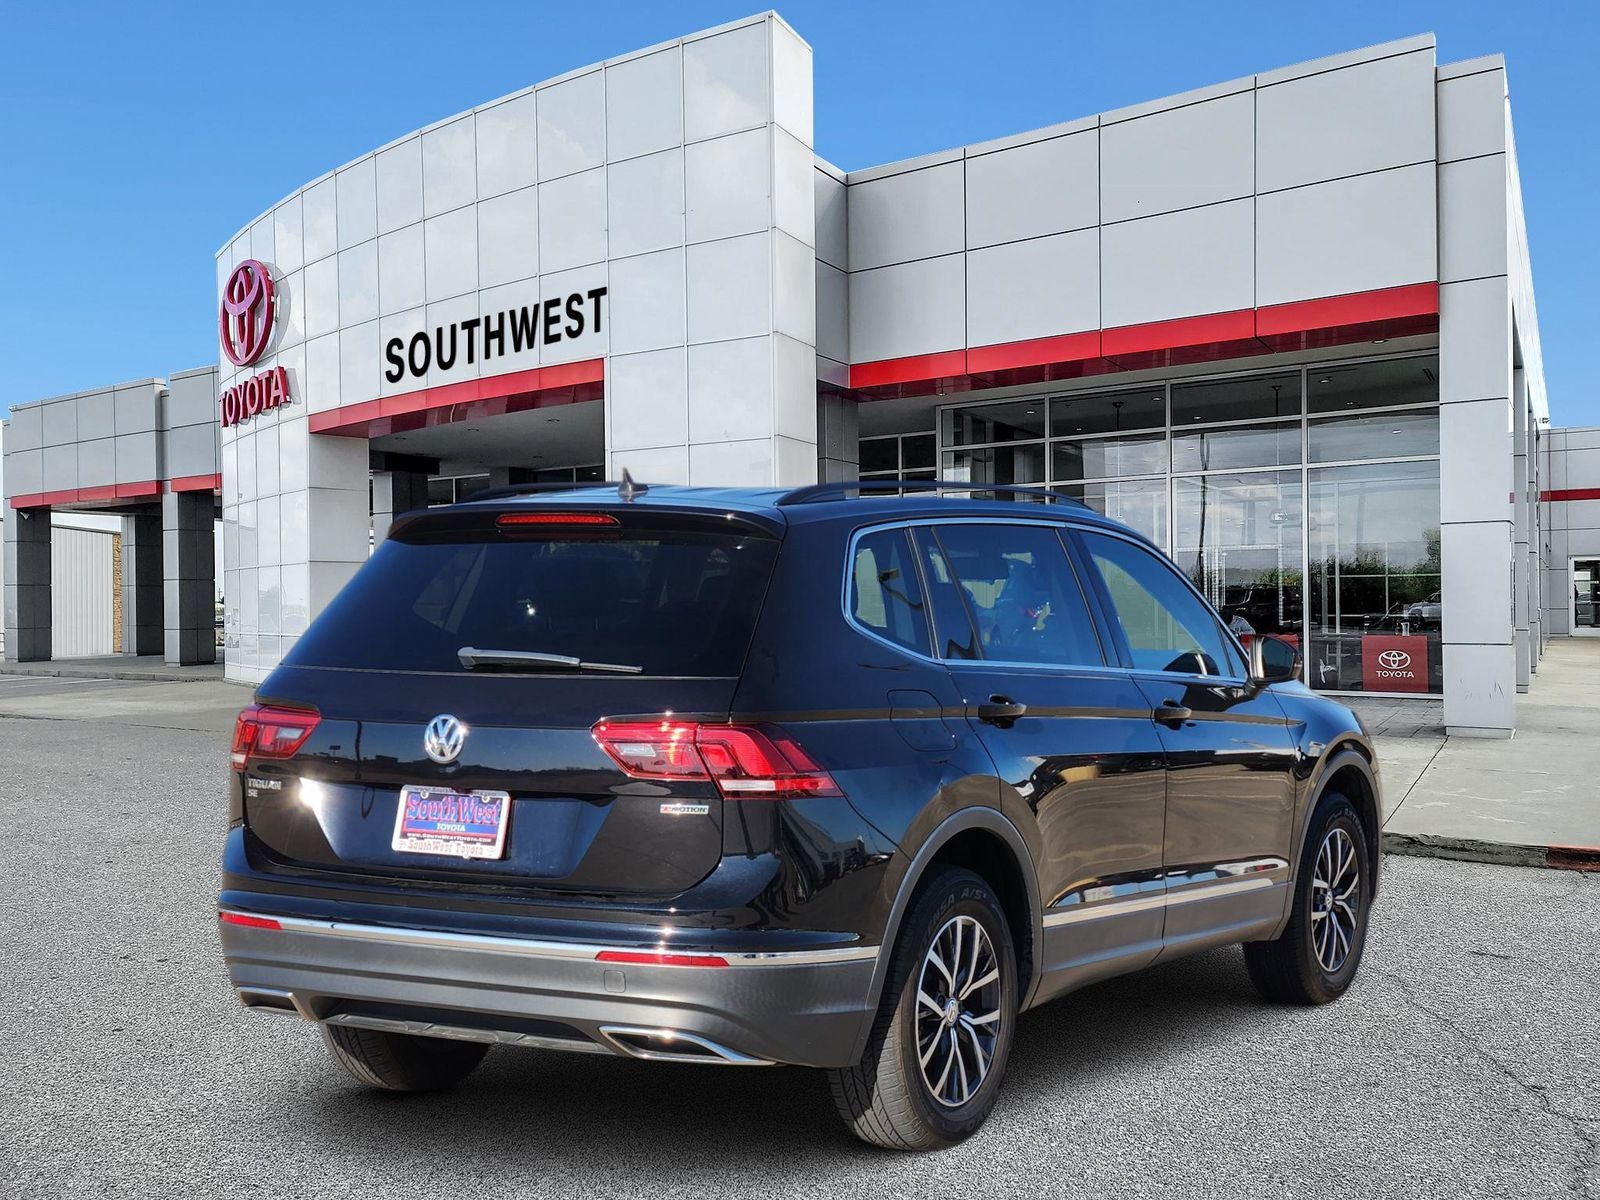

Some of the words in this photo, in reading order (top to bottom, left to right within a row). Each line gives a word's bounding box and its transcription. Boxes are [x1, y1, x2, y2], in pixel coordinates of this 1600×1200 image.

[385, 286, 608, 384] SOUTHWEST
[218, 366, 292, 428] TOYOTA
[1376, 670, 1415, 679] TOYOTA
[247, 778, 283, 791] TIGUAN
[436, 823, 466, 832] TOYOTA
